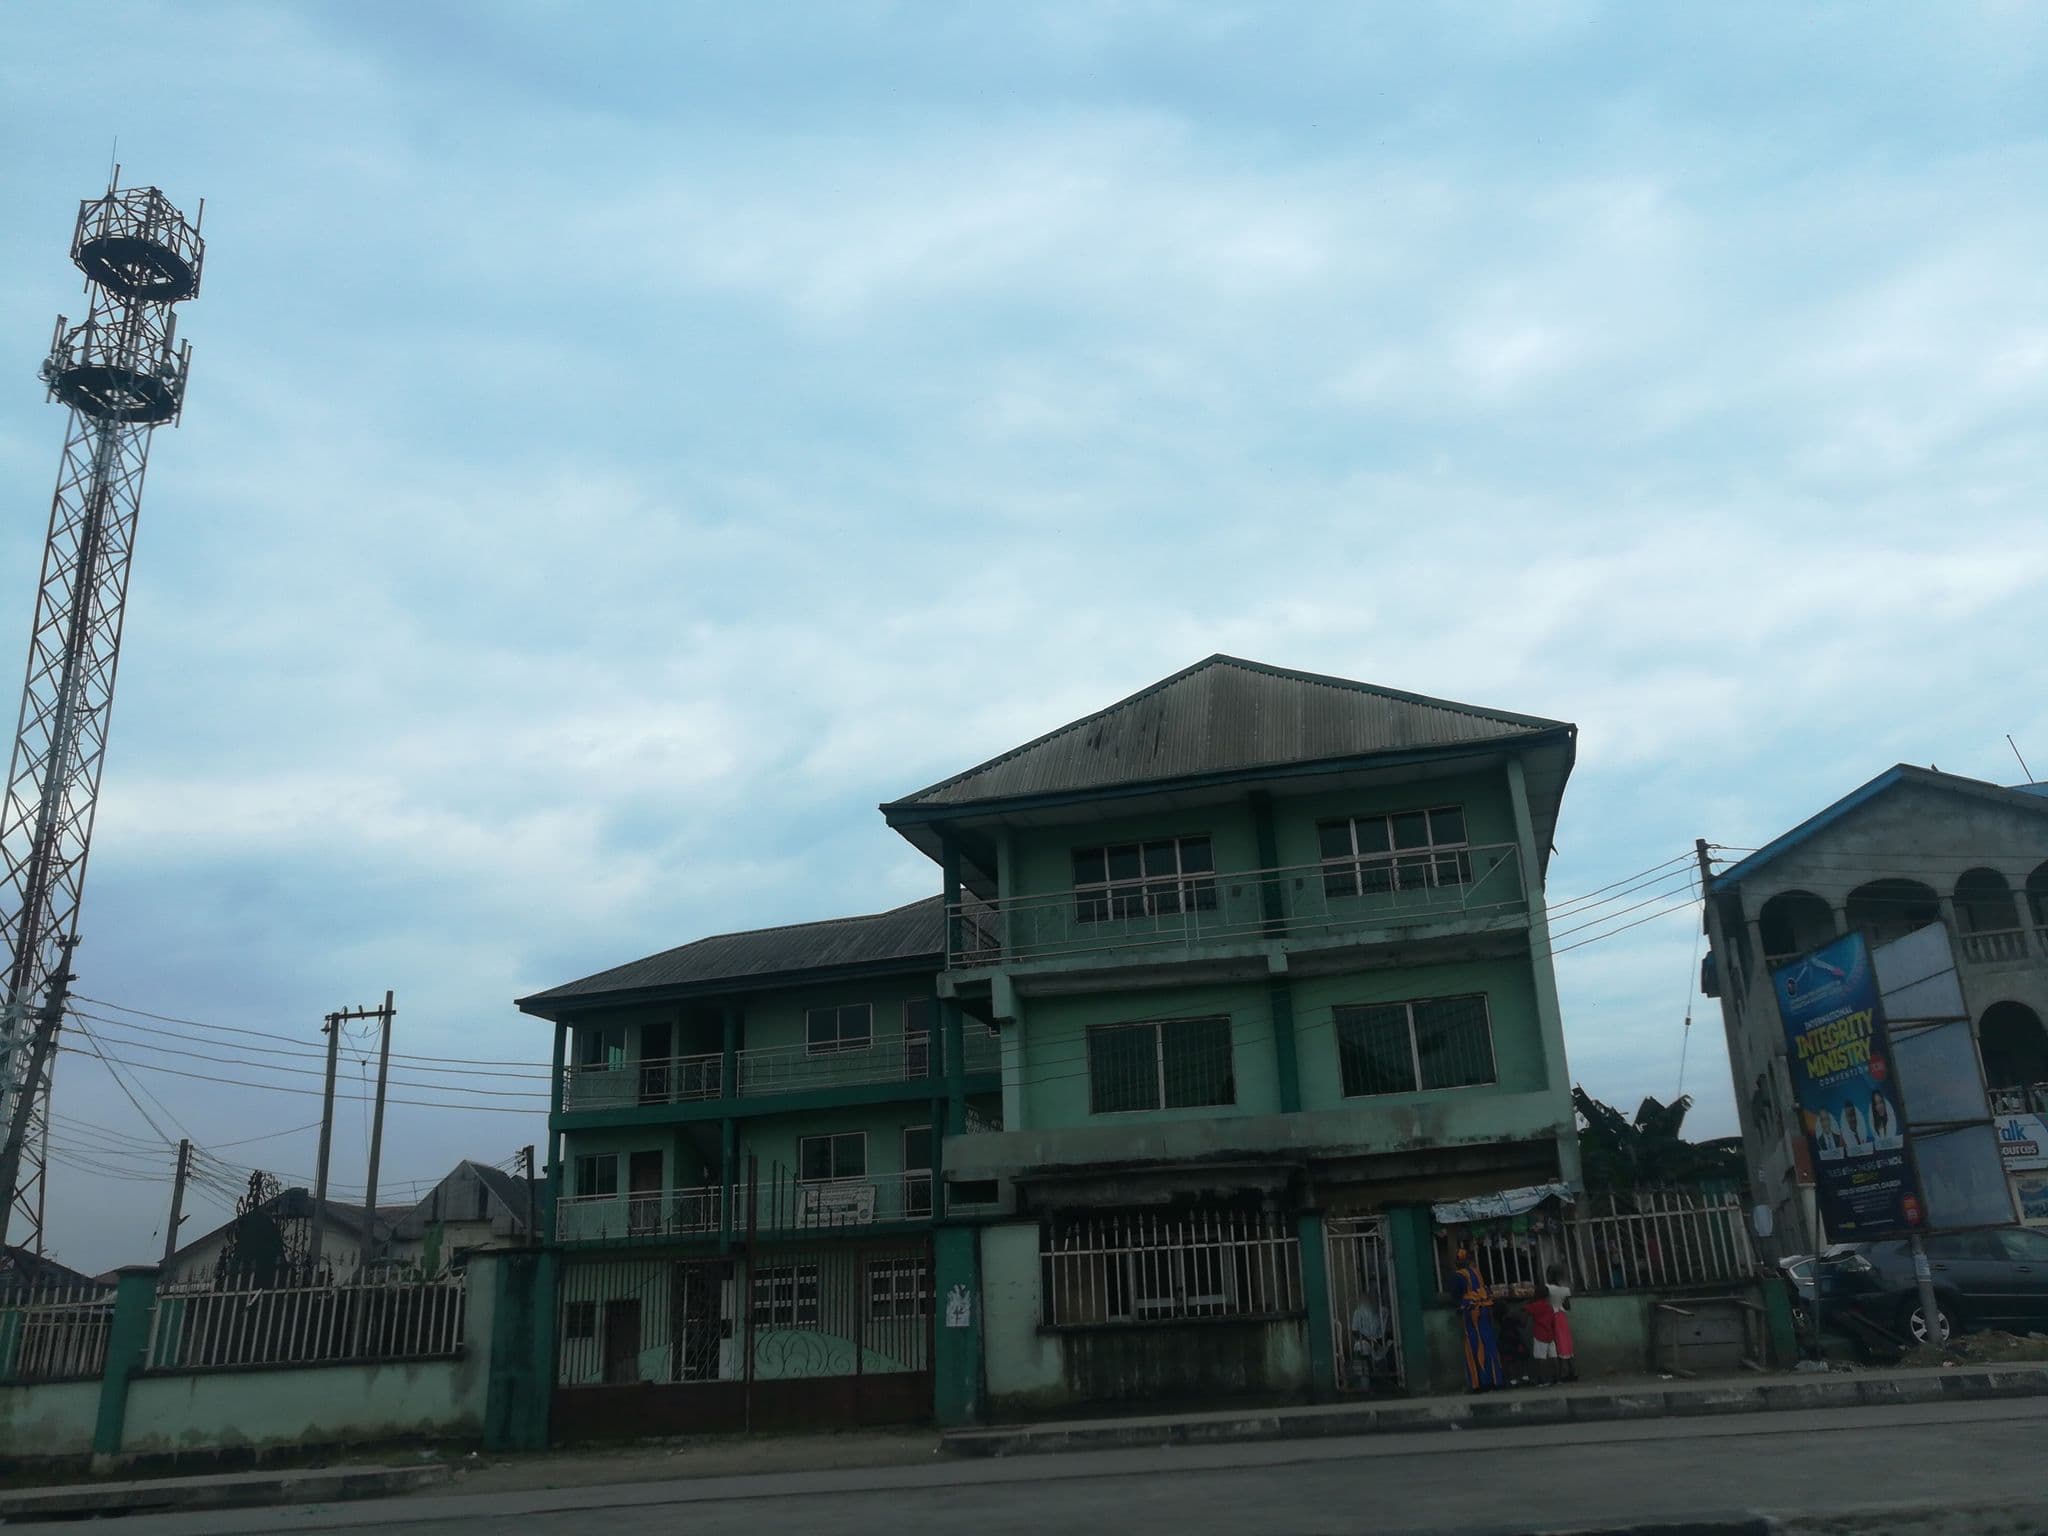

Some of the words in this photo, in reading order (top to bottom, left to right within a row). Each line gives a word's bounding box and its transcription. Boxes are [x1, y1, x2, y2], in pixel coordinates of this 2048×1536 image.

[1795, 1008, 1873, 1058] INTEGRITY
[1807, 1037, 1872, 1079] MINISTRY
[1998, 1119, 2027, 1141] alk
[2001, 1144, 2038, 1156] ources
